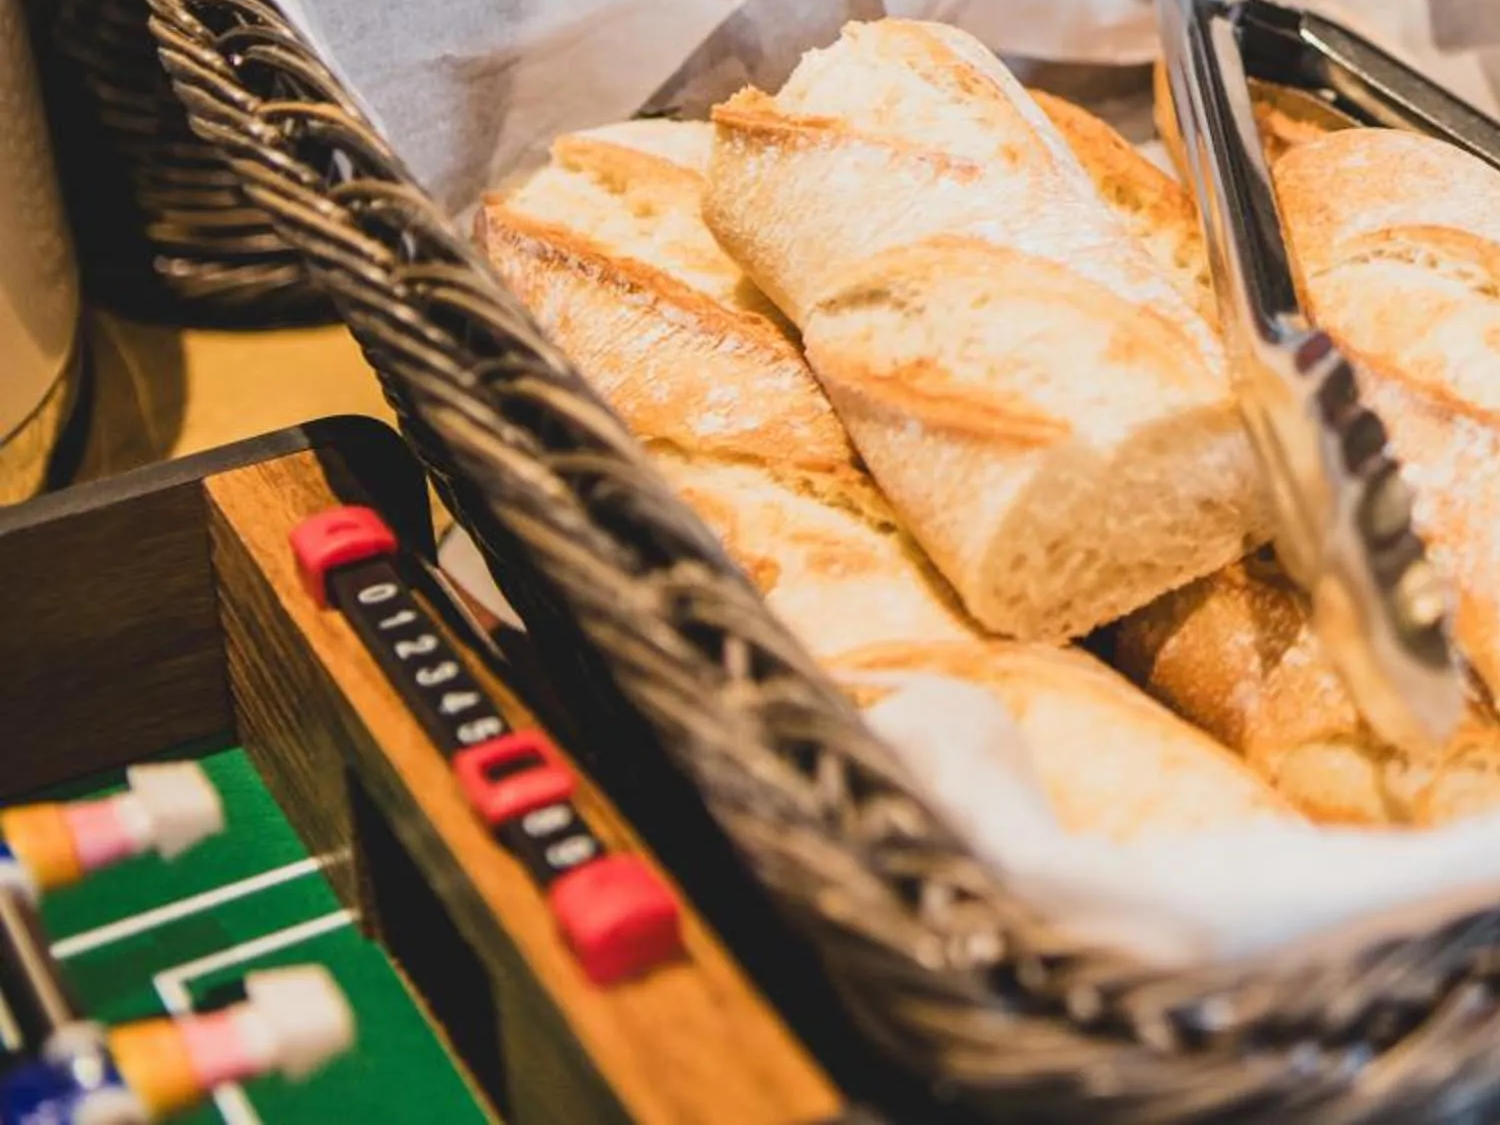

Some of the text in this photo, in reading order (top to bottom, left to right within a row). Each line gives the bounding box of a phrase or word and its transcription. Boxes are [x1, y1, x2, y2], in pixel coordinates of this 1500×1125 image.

[357, 583, 398, 604] 0
[378, 609, 417, 629] 1
[395, 634, 439, 659] 2
[416, 661, 459, 686] 3
[439, 692, 481, 714] 4
[457, 717, 502, 744] 5
